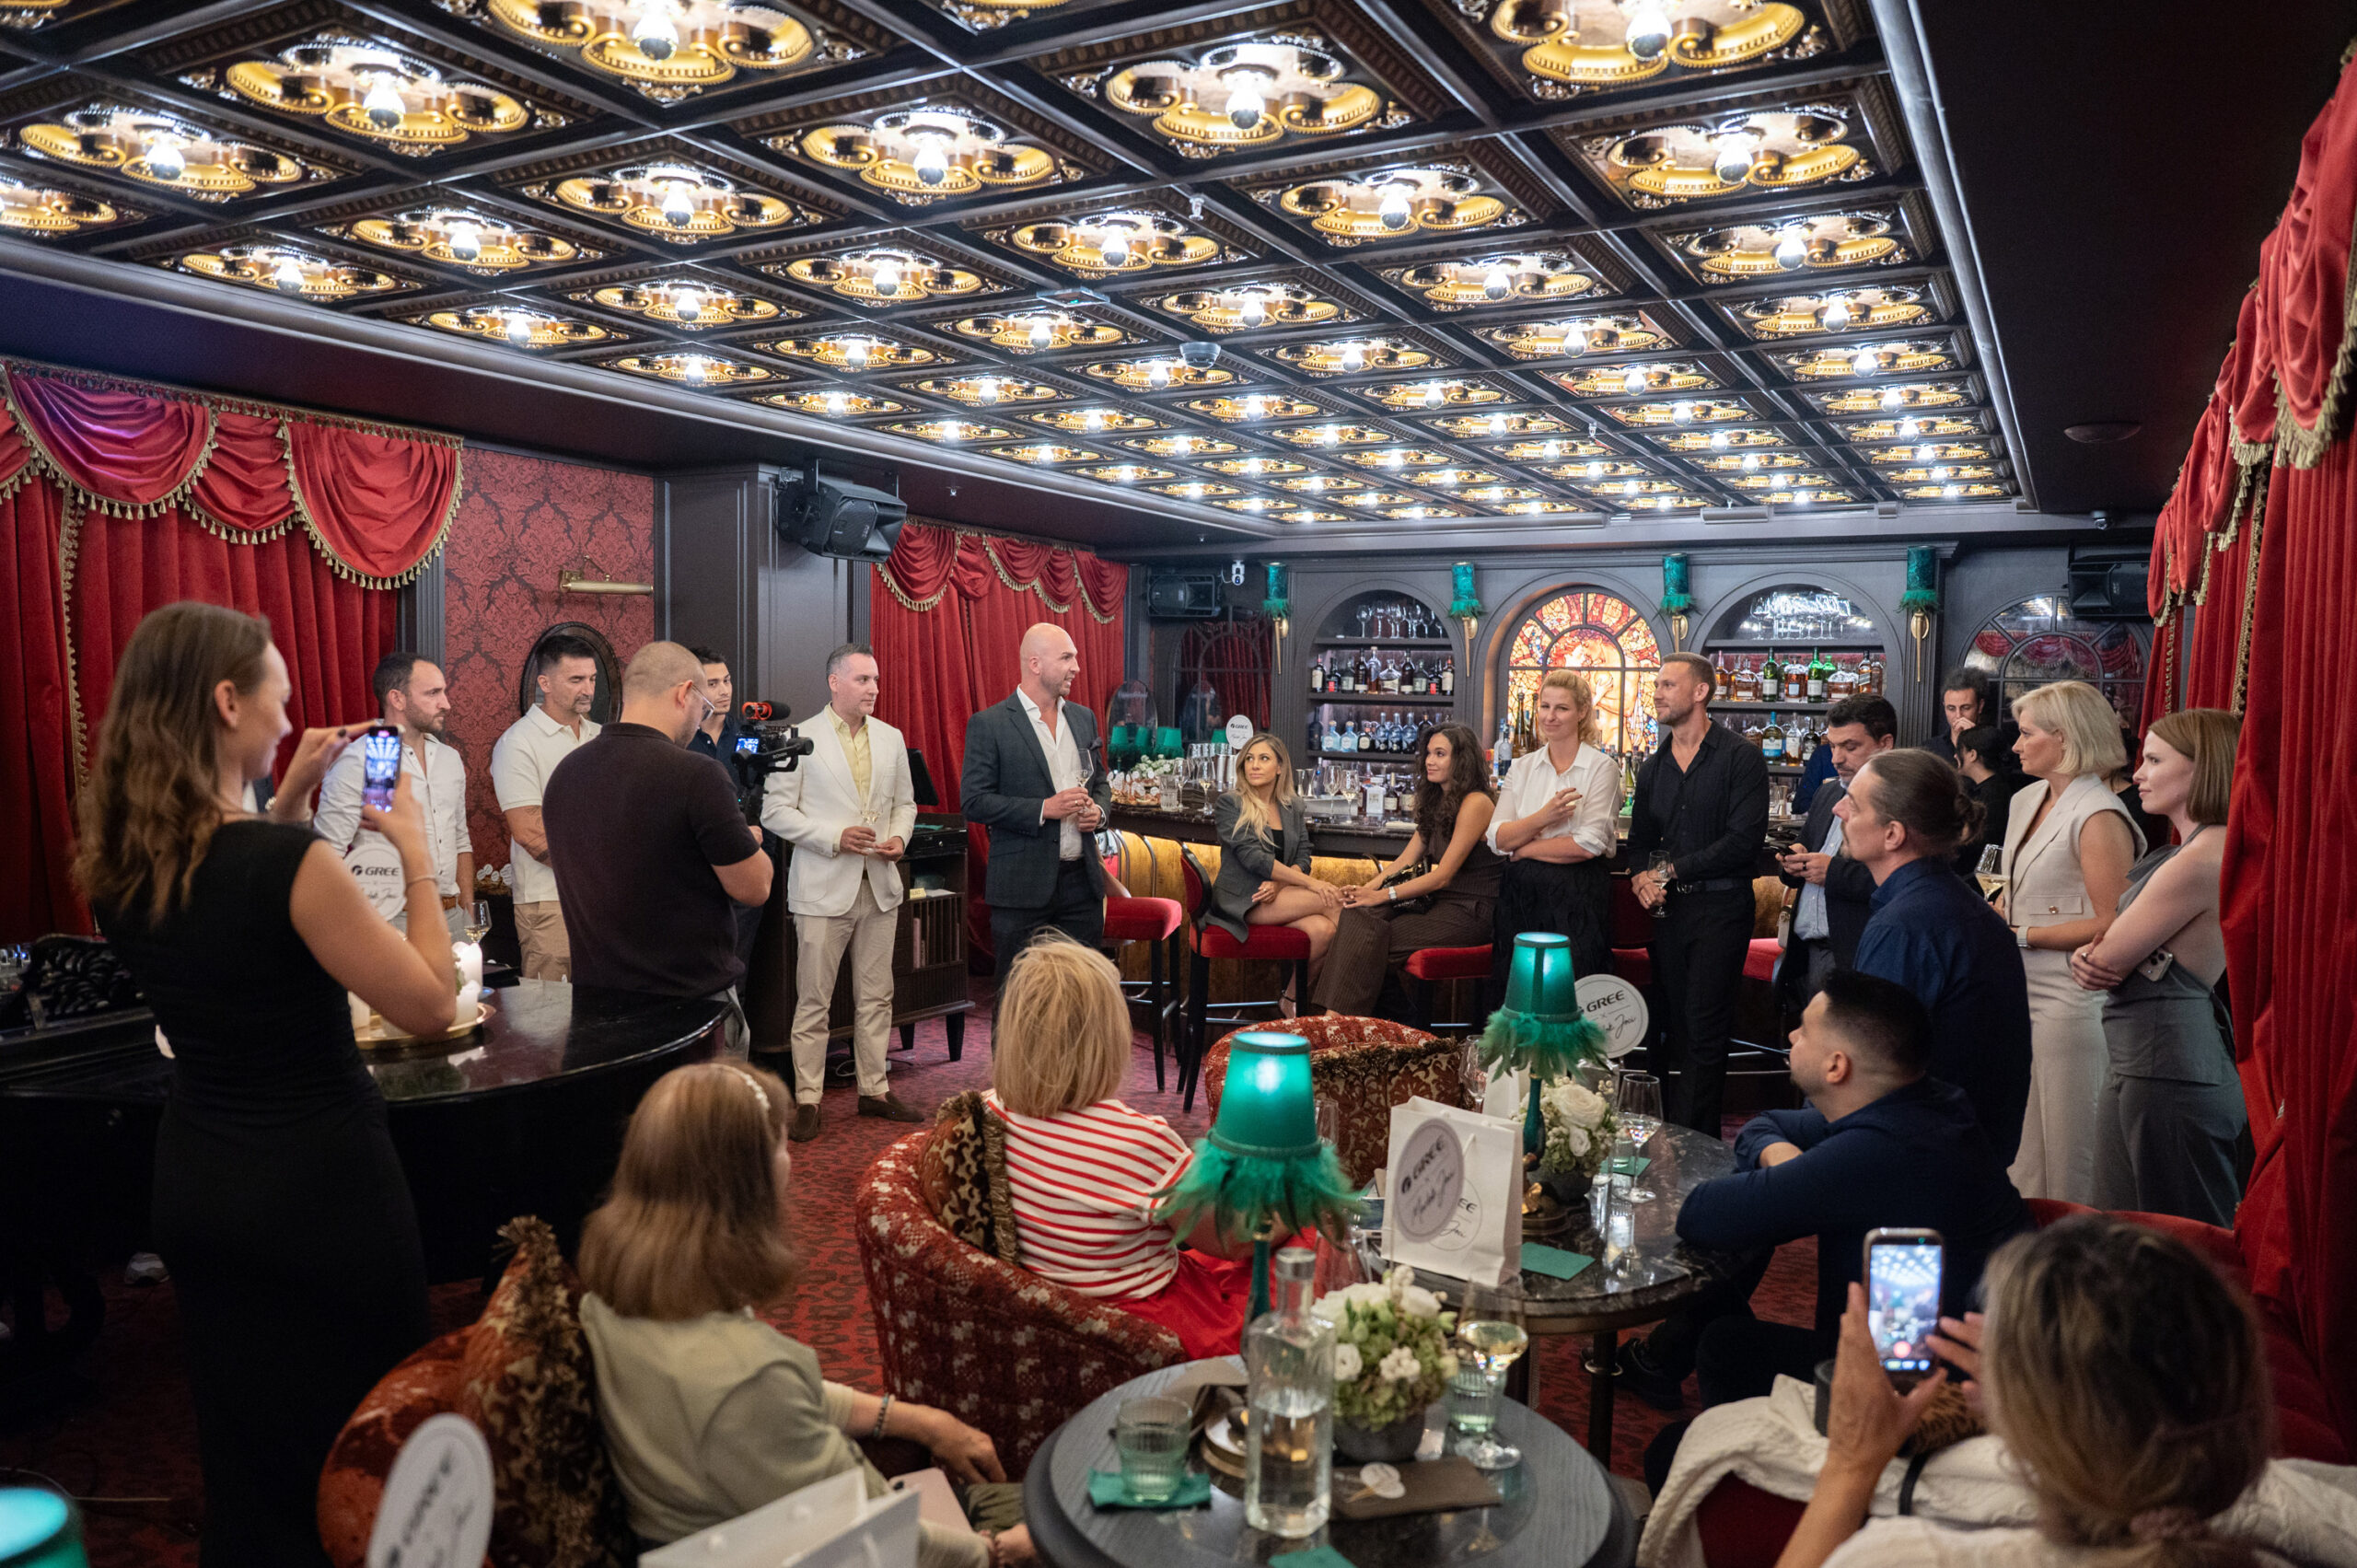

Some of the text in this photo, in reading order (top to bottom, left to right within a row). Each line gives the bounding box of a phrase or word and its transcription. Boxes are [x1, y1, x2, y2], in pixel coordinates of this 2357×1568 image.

[365, 866, 400, 877] GREE
[1586, 990, 1625, 1013] GREE
[1457, 1197, 1478, 1214] EE
